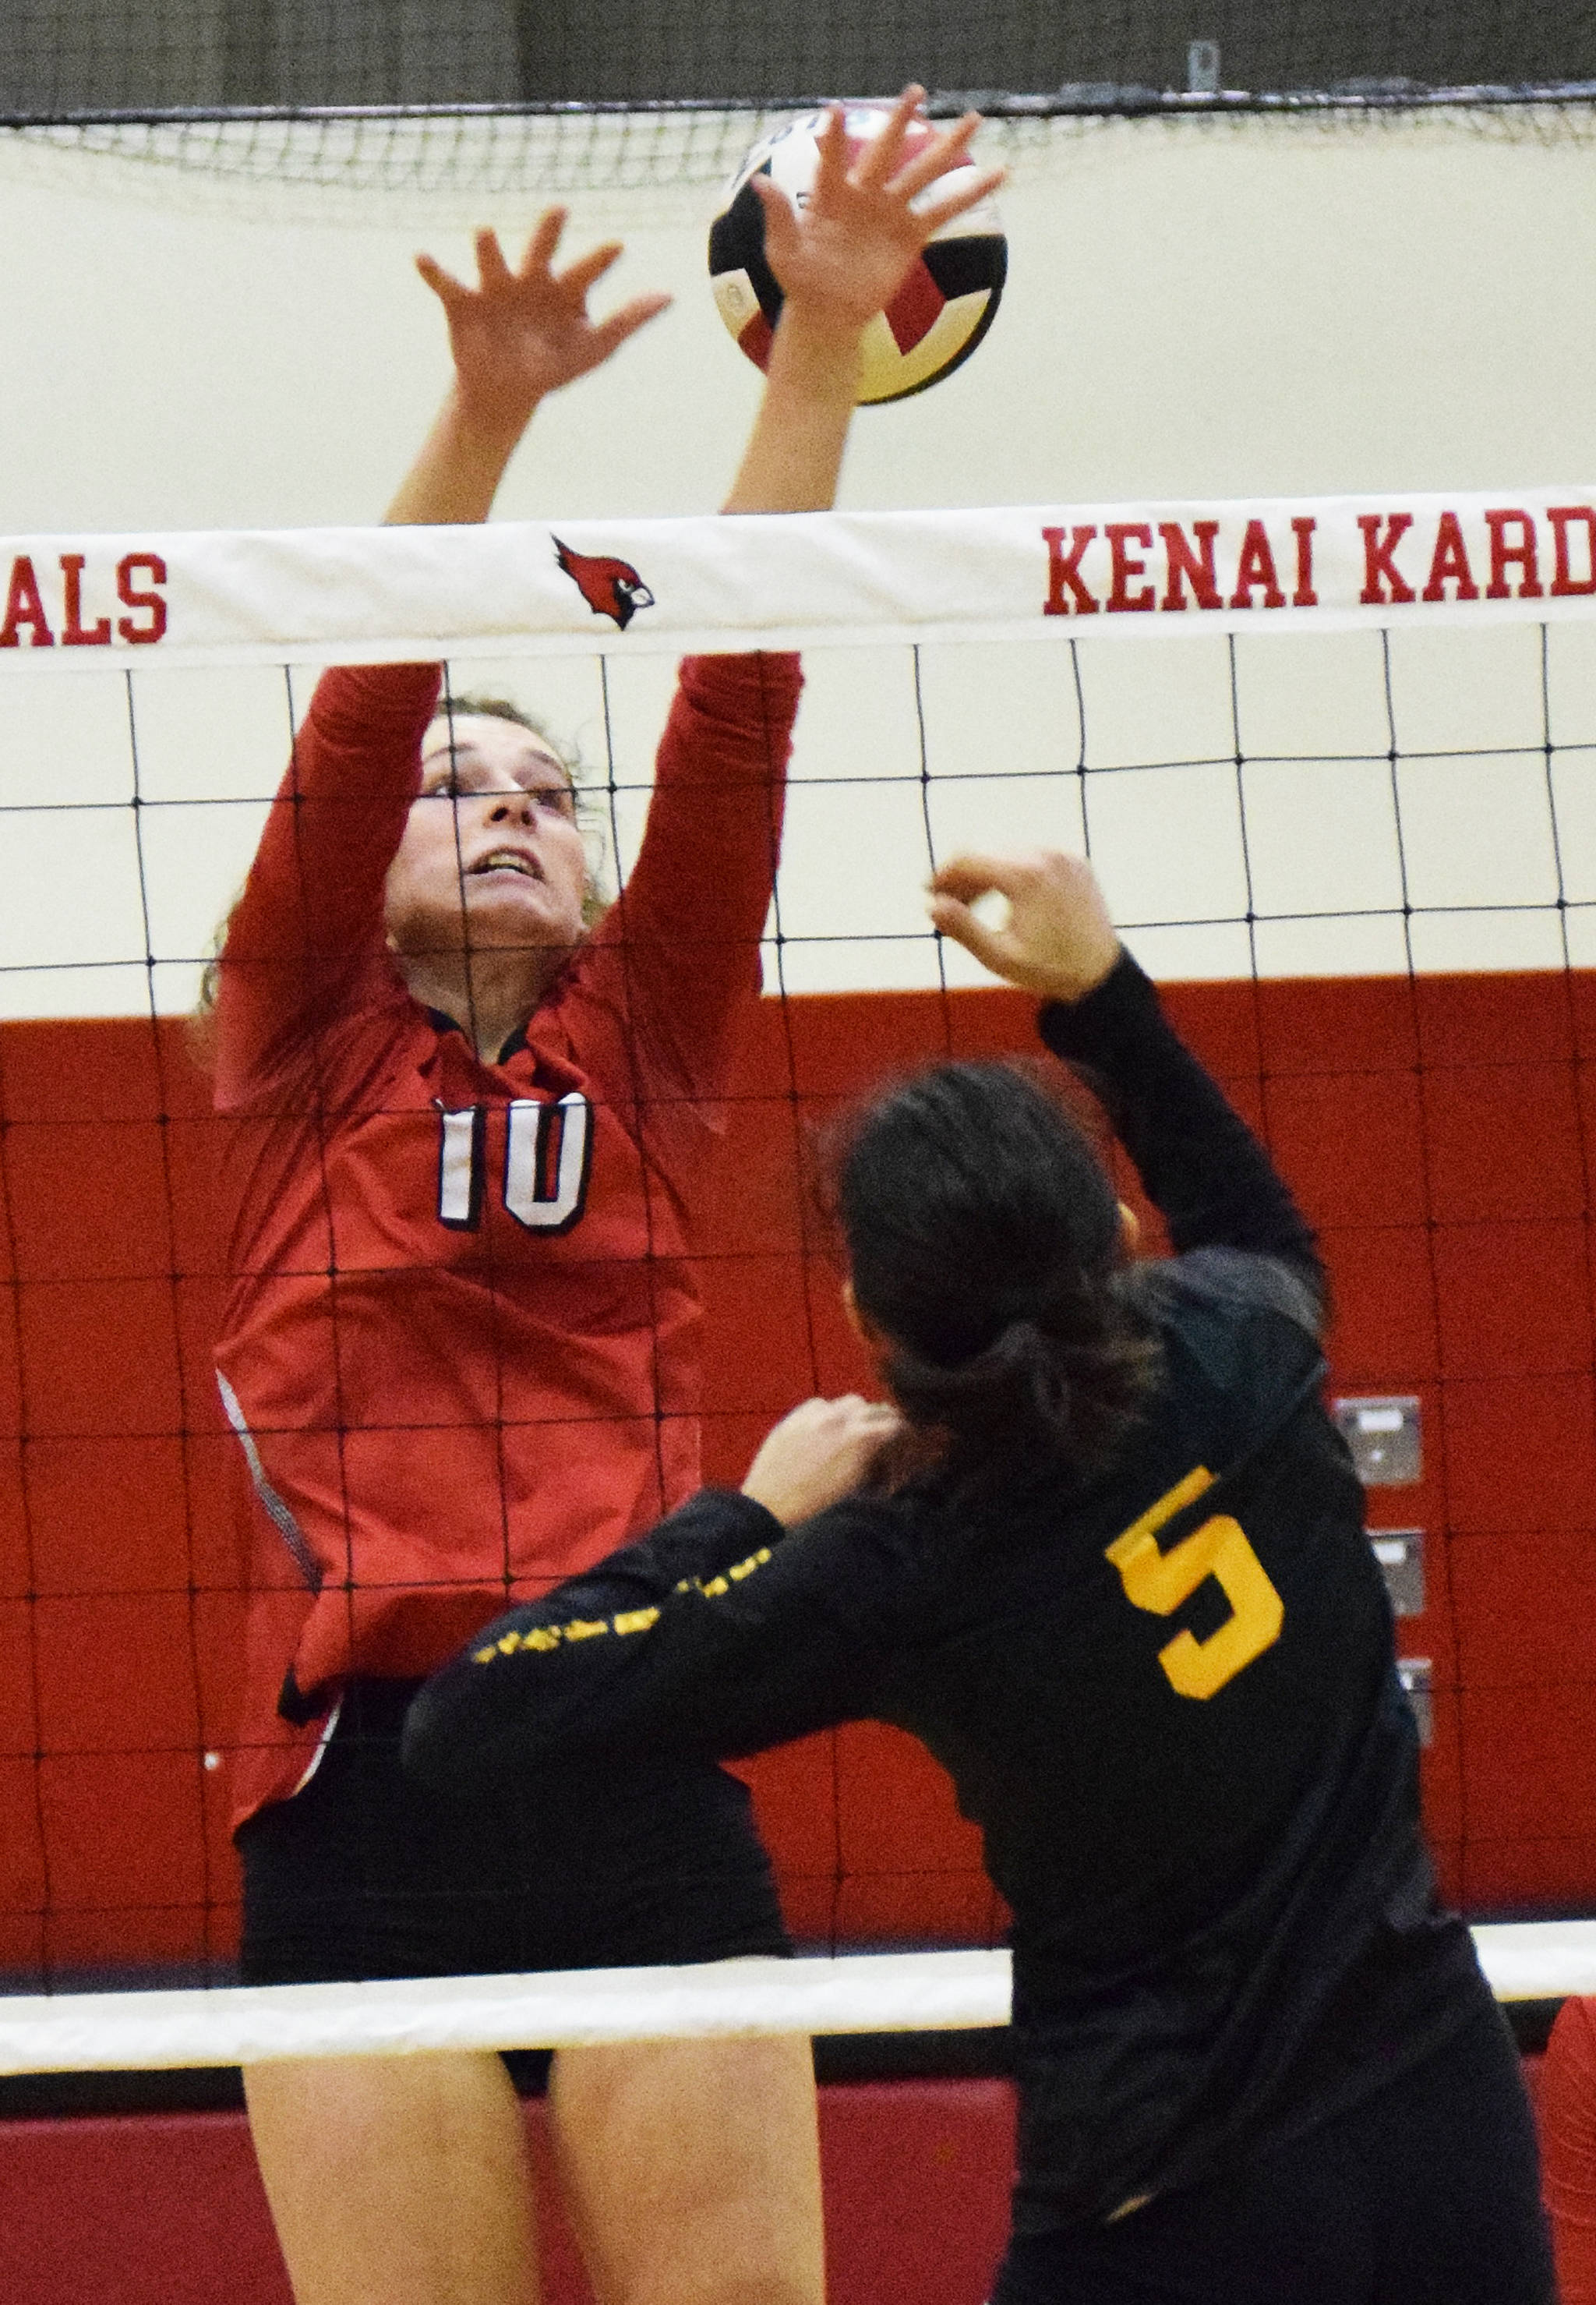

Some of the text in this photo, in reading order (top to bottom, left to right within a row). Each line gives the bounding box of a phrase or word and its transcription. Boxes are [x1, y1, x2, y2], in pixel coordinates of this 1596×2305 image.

[0, 552, 167, 648] ALS
[1042, 506, 1596, 615] KENAI KARD
[433, 1091, 595, 1236] 10
[1104, 1464, 1285, 1700] 5
